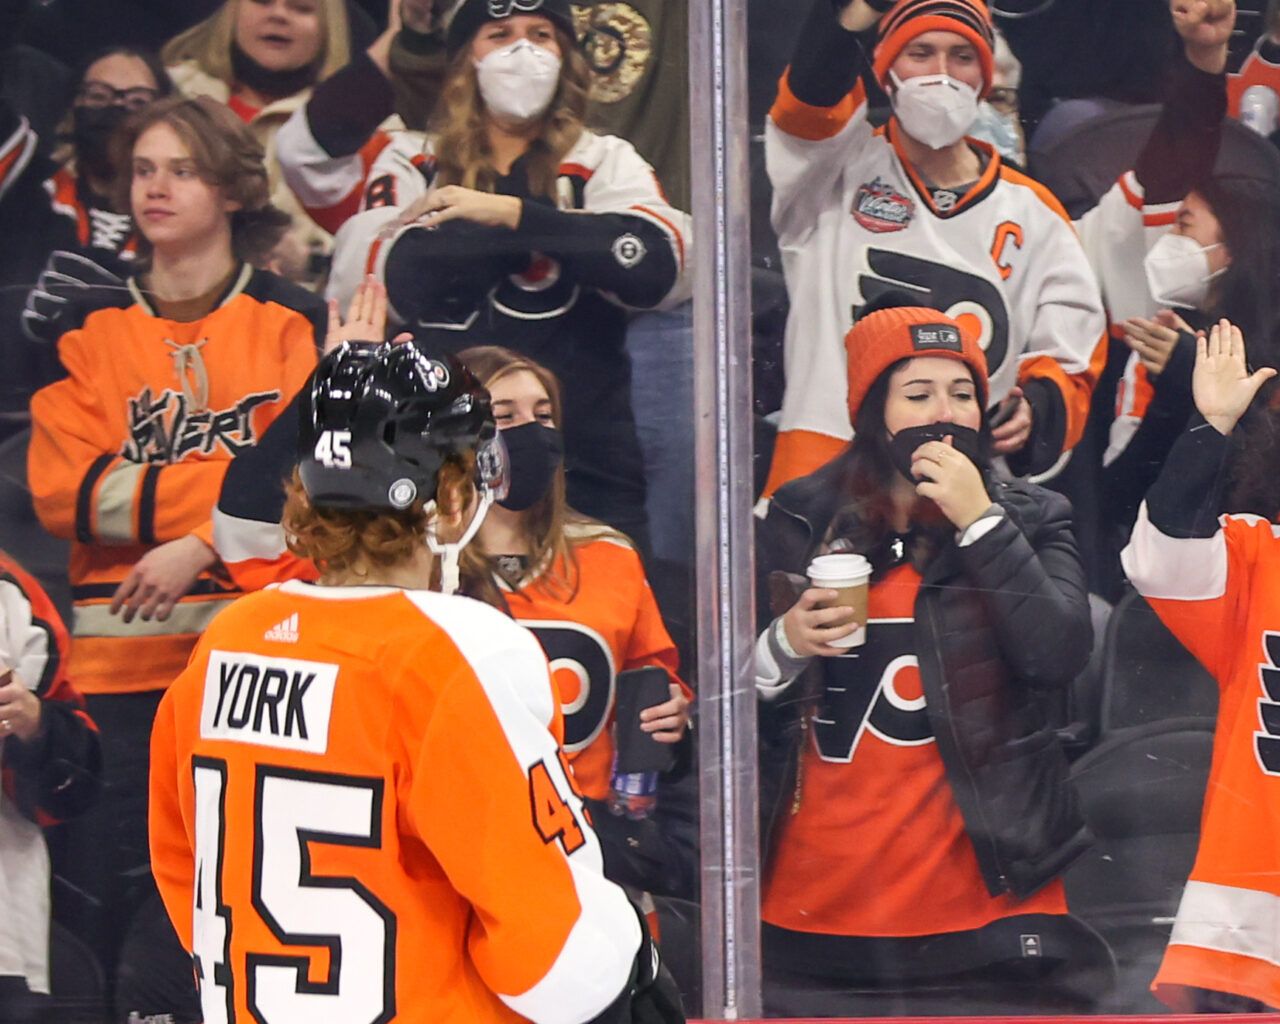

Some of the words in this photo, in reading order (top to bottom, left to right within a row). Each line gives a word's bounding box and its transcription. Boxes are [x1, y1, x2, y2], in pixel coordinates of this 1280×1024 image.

[989, 219, 1024, 281] C
[314, 429, 352, 470] 45
[212, 661, 317, 741] YORK
[527, 747, 593, 857] 4
